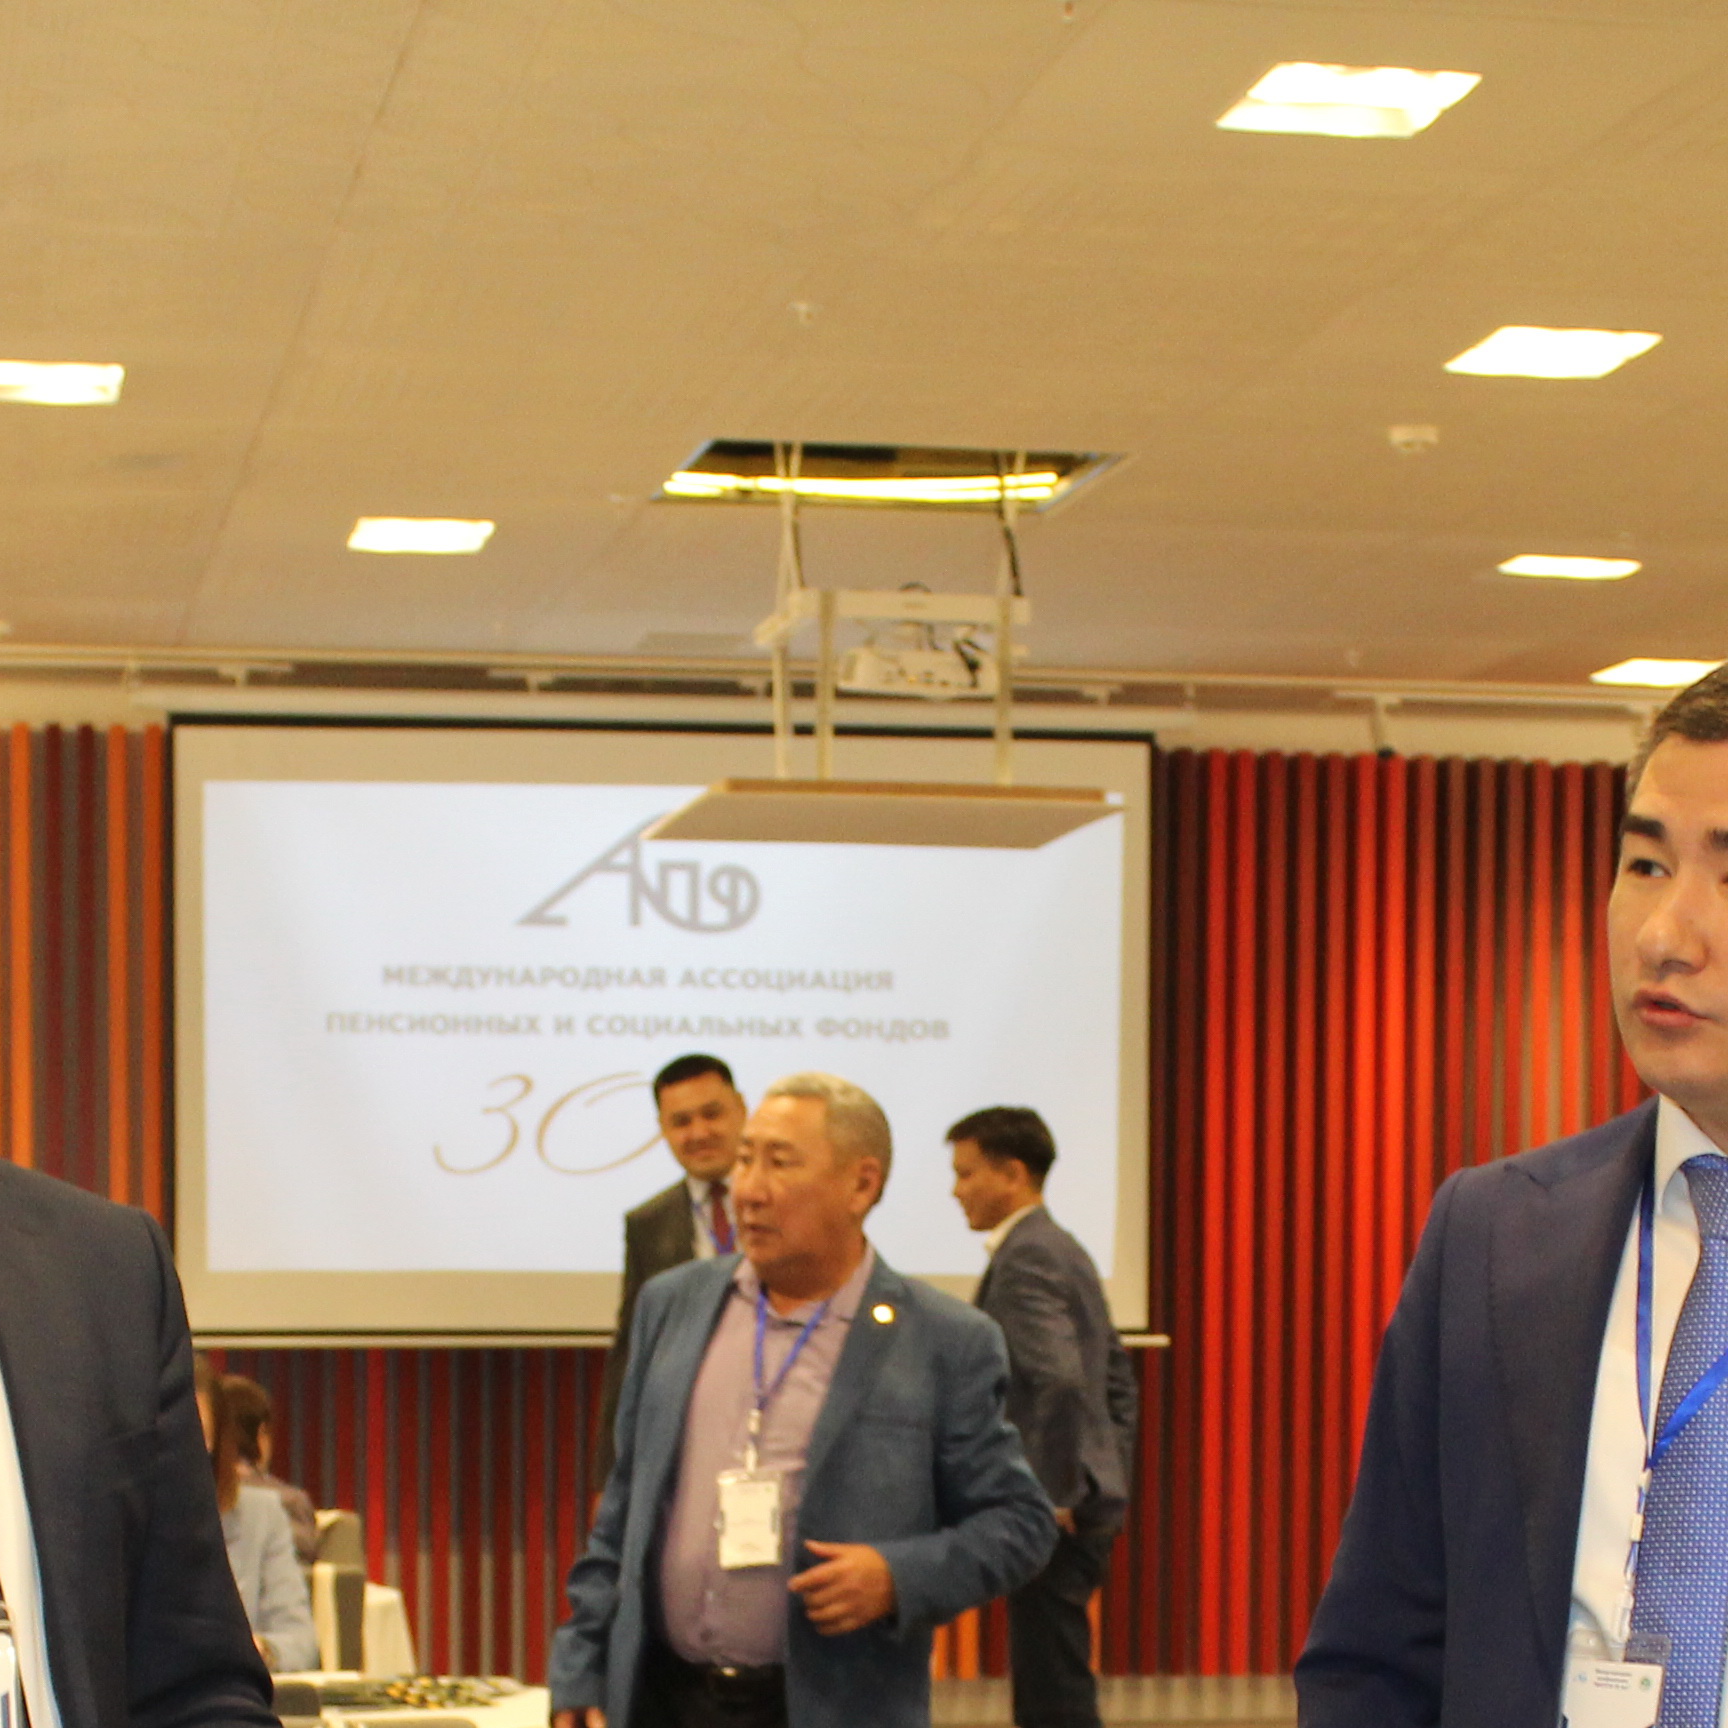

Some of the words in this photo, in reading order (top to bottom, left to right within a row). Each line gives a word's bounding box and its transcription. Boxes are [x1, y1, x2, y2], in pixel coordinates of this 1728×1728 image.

[381, 965, 667, 990] МЕЖДУНАРОДНАЯ
[679, 968, 895, 994] АССОЦИАЦИЯ
[325, 1011, 542, 1035] ПЕНСИОННЫХ
[553, 1014, 574, 1035] И
[586, 1014, 803, 1040] СОЦИАЛЬНЫХ
[816, 1016, 950, 1042] ФОНДОВ
